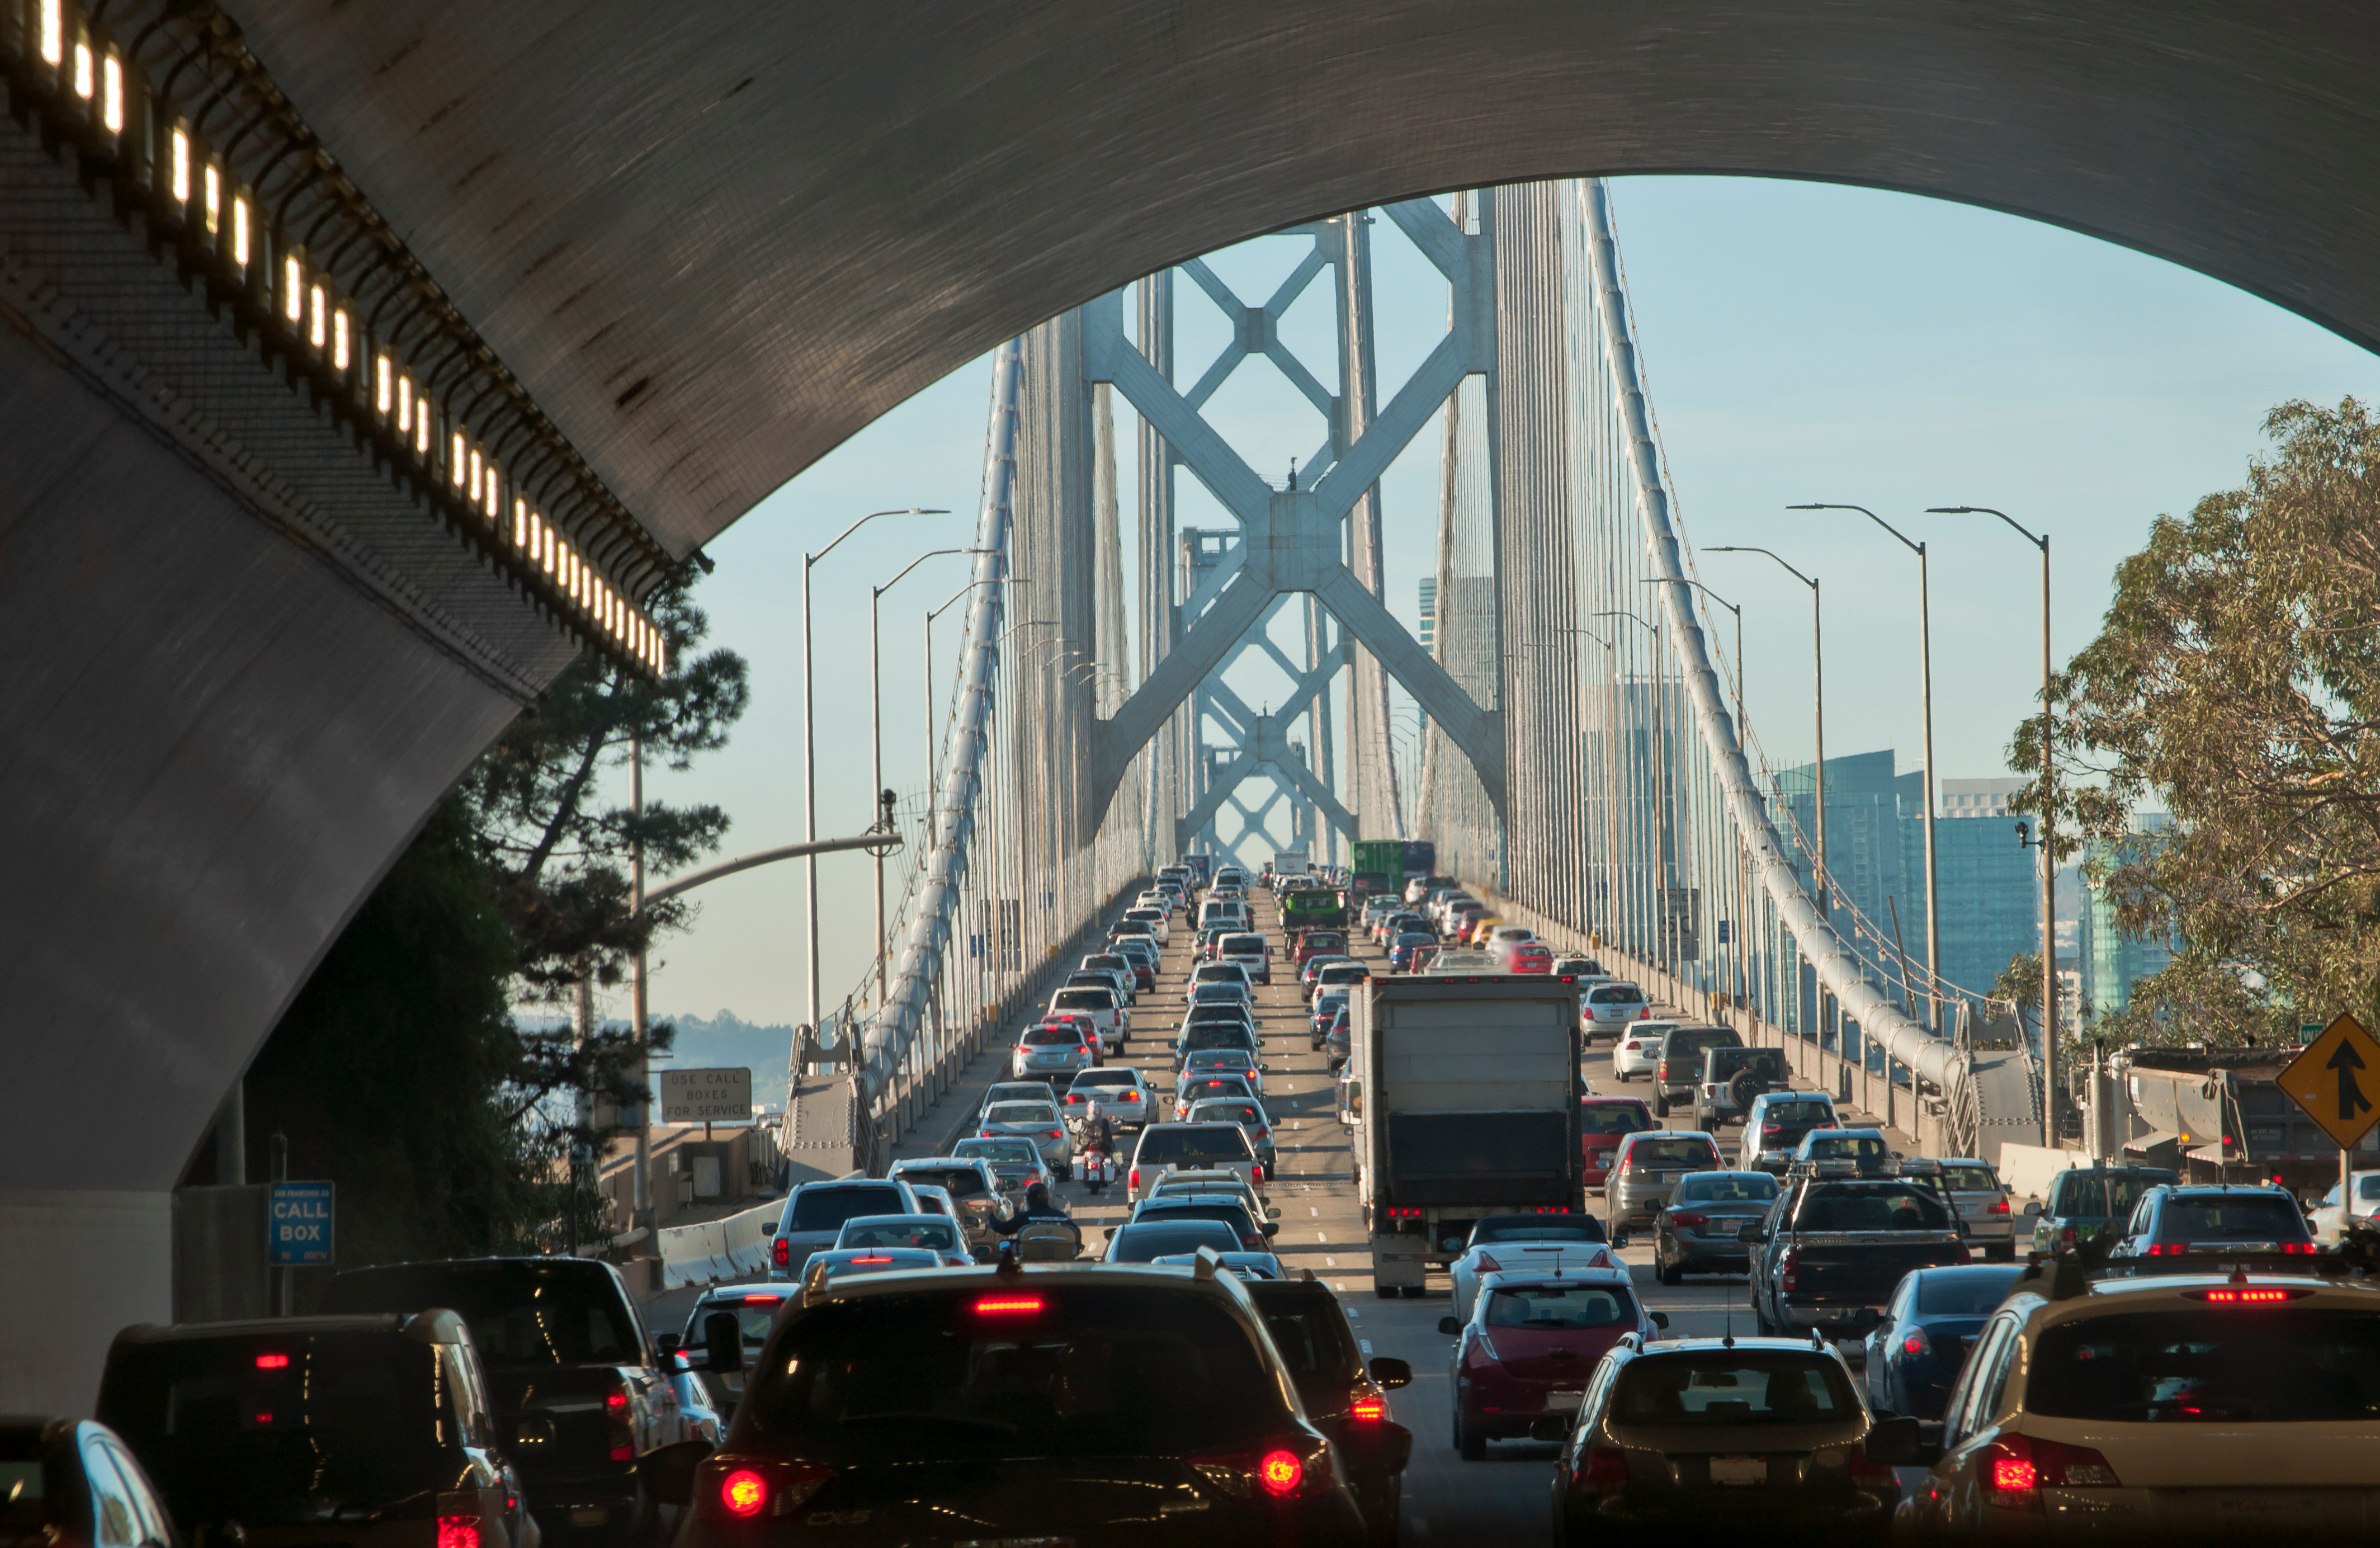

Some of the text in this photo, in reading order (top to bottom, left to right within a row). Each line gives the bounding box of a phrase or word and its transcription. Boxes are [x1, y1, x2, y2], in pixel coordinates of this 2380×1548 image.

[672, 1073, 739, 1084] USE CALL
[687, 1089, 727, 1100] BOXES
[667, 1104, 747, 1117] FOR SERVICE
[274, 1202, 329, 1219] CALL
[280, 1224, 320, 1241] BOX
